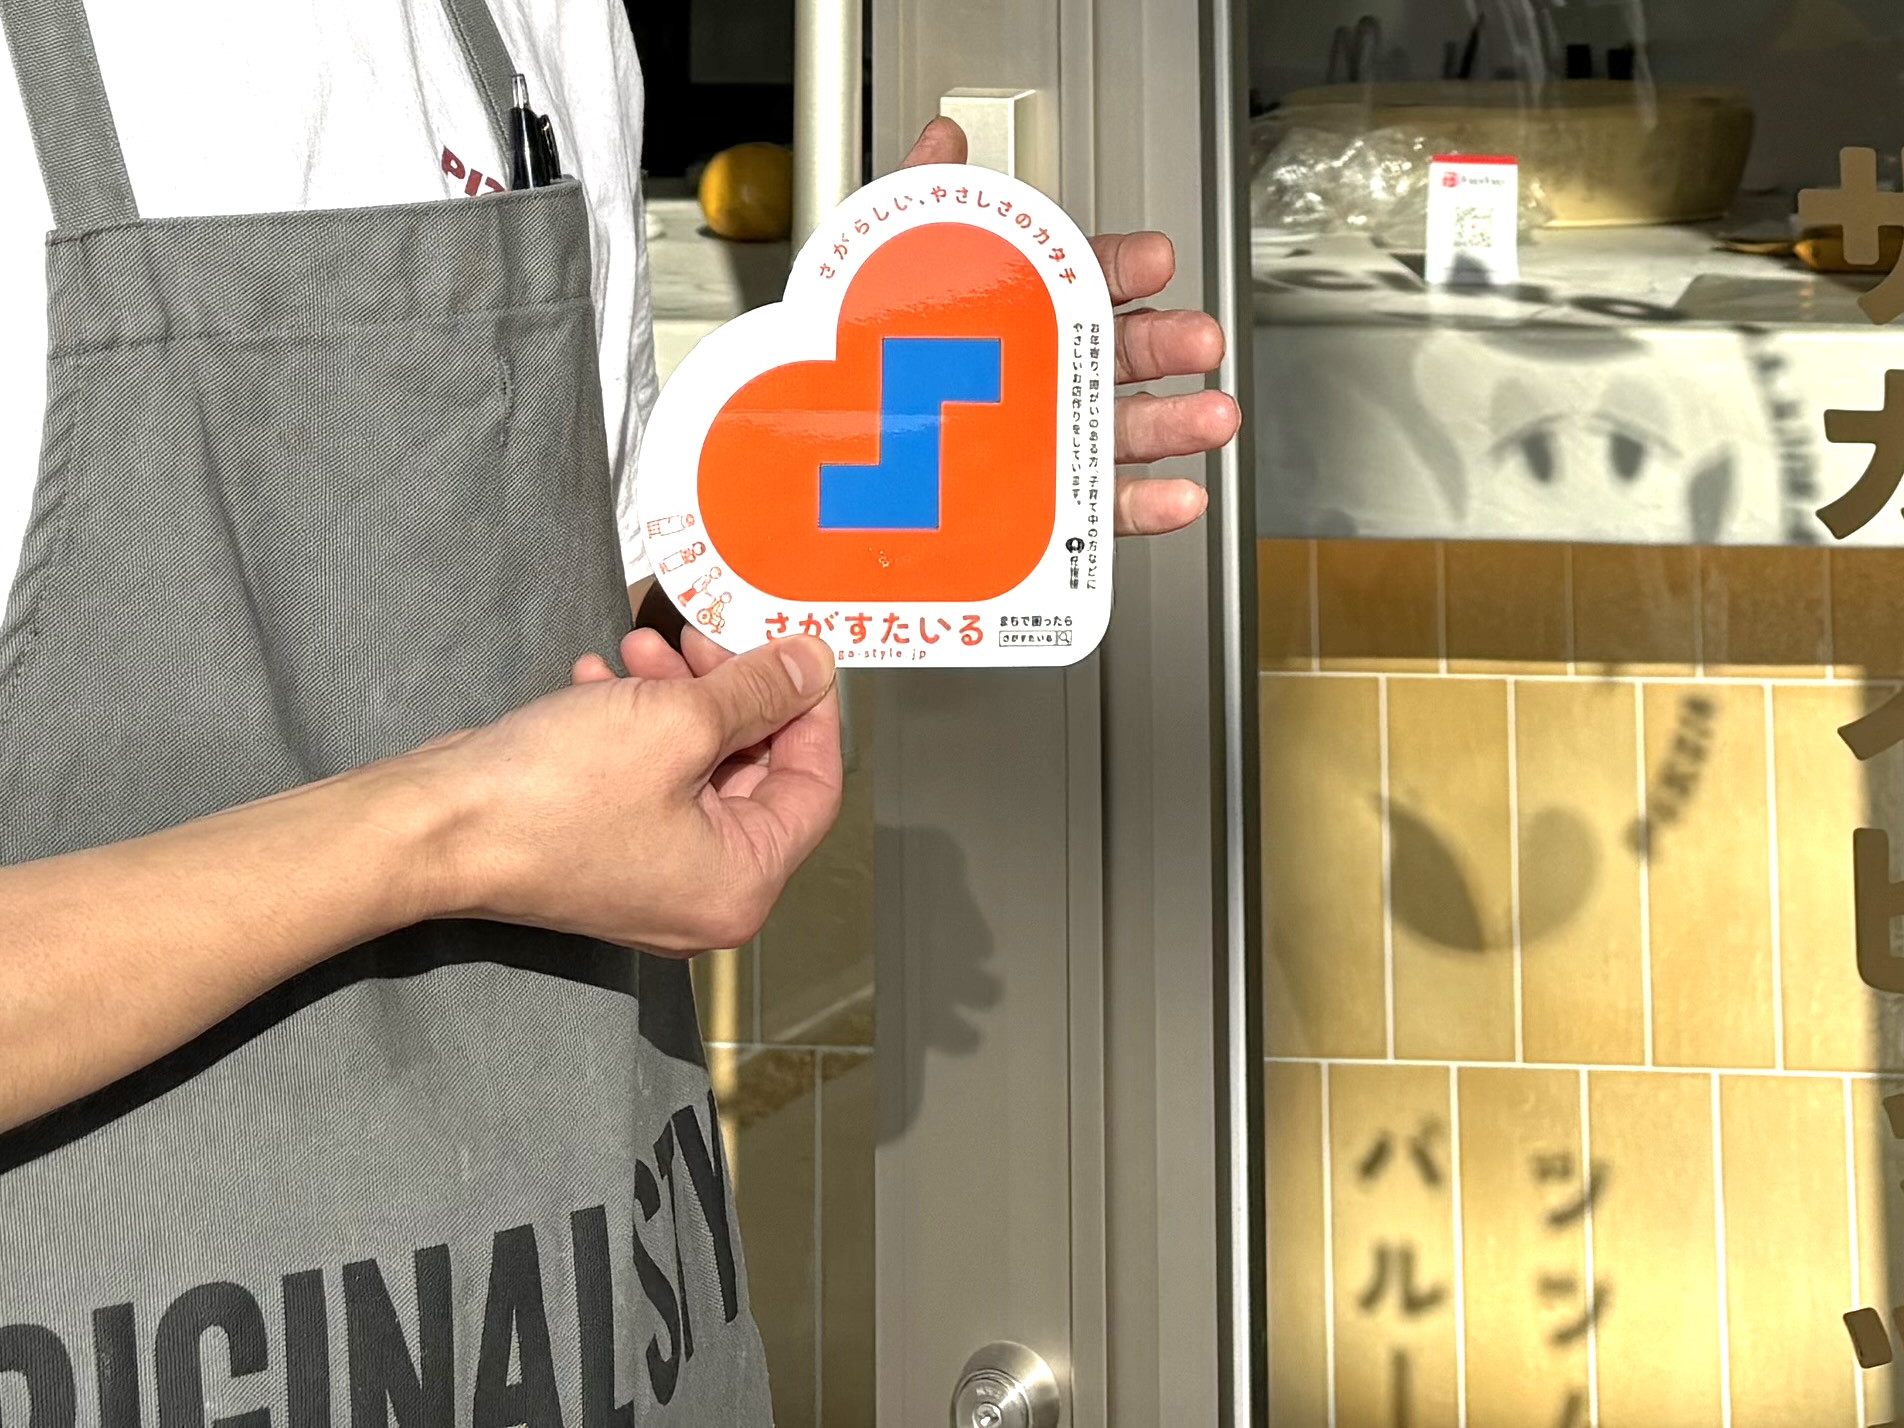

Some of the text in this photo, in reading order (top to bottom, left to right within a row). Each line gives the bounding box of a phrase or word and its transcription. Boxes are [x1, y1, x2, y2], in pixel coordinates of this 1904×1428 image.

[819, 185, 1077, 284] さがらしい、やさしさのカタチ
[764, 611, 985, 647] さがすたいる
[838, 647, 928, 661] ga-style.jp
